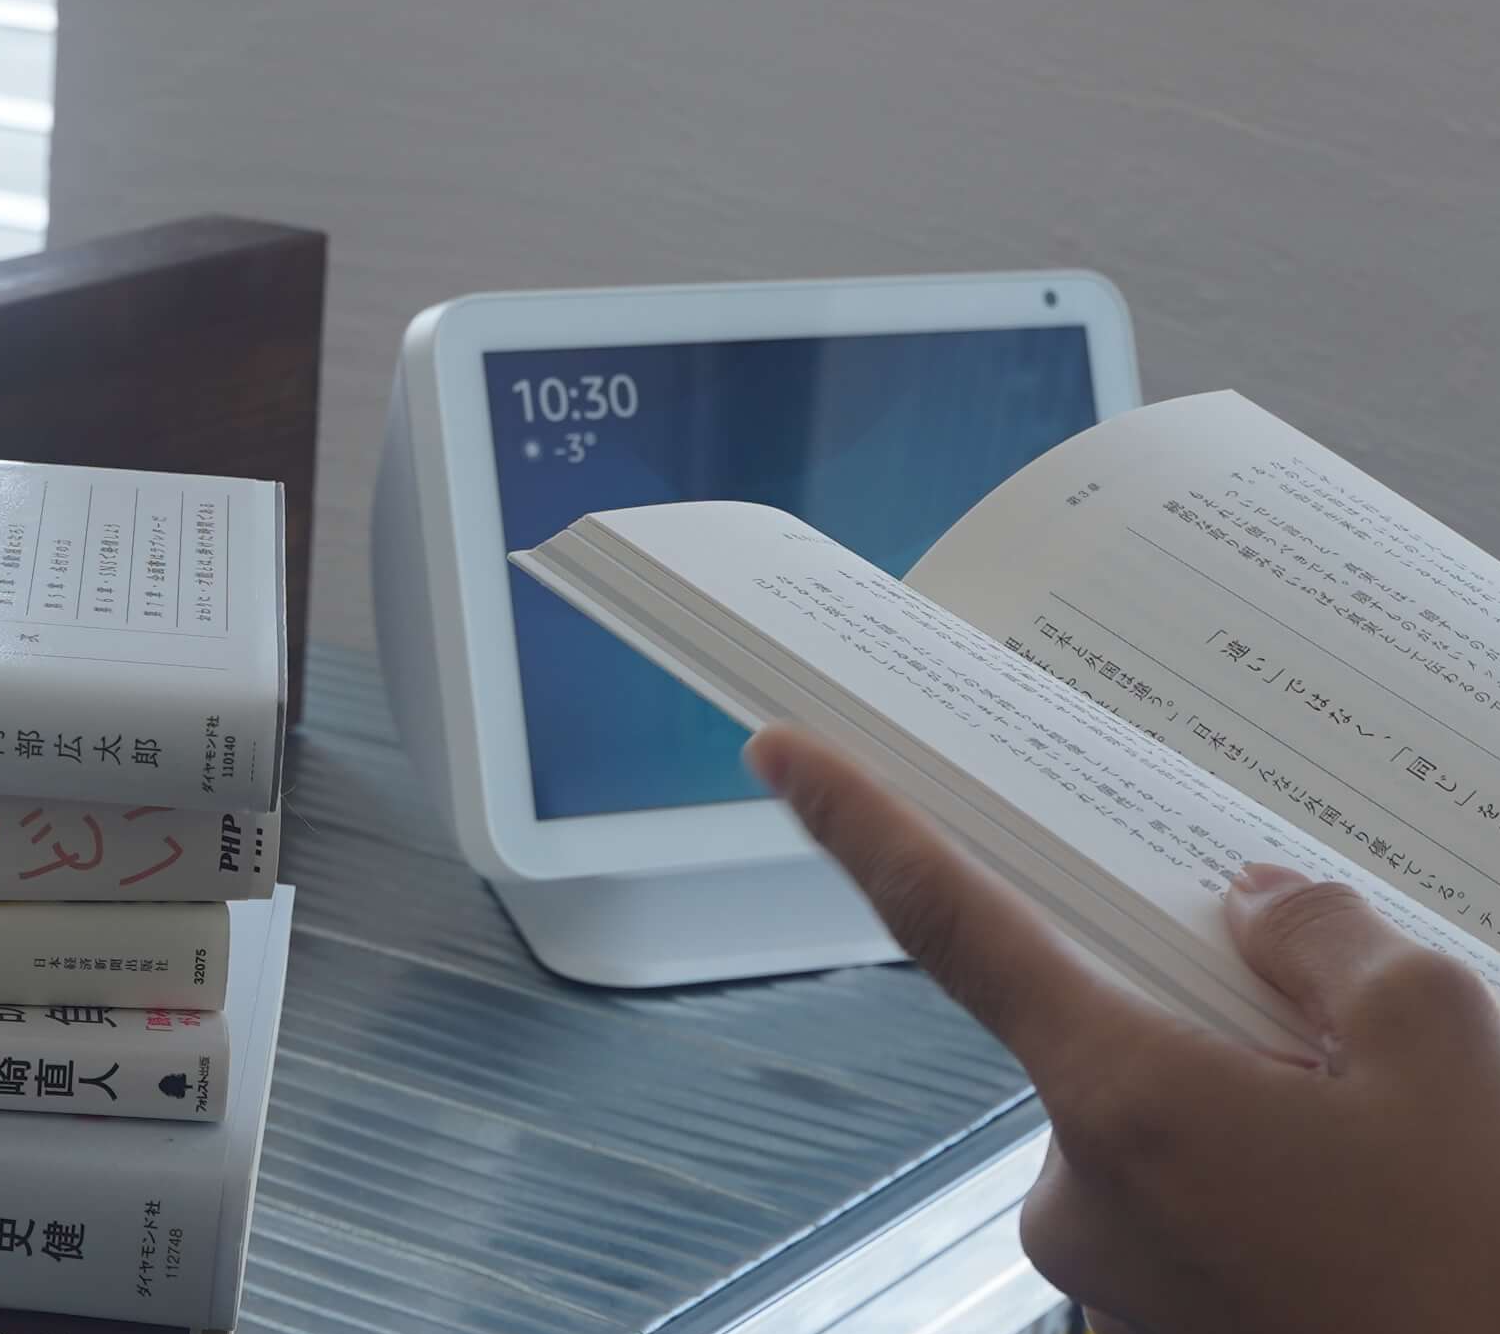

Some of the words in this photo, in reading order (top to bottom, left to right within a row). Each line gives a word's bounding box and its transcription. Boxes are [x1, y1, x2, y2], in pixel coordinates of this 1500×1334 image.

[511, 373, 639, 423] 10:30
[200, 715, 222, 794] ダイヤモンド社
[221, 734, 237, 779] 110140
[218, 812, 243, 874] PHP
[33, 956, 170, 973] 日本経済新聞出版社
[193, 948, 207, 986] 32075
[135, 1198, 162, 1299] ダイヤモンド社
[165, 1227, 184, 1280] 112748
